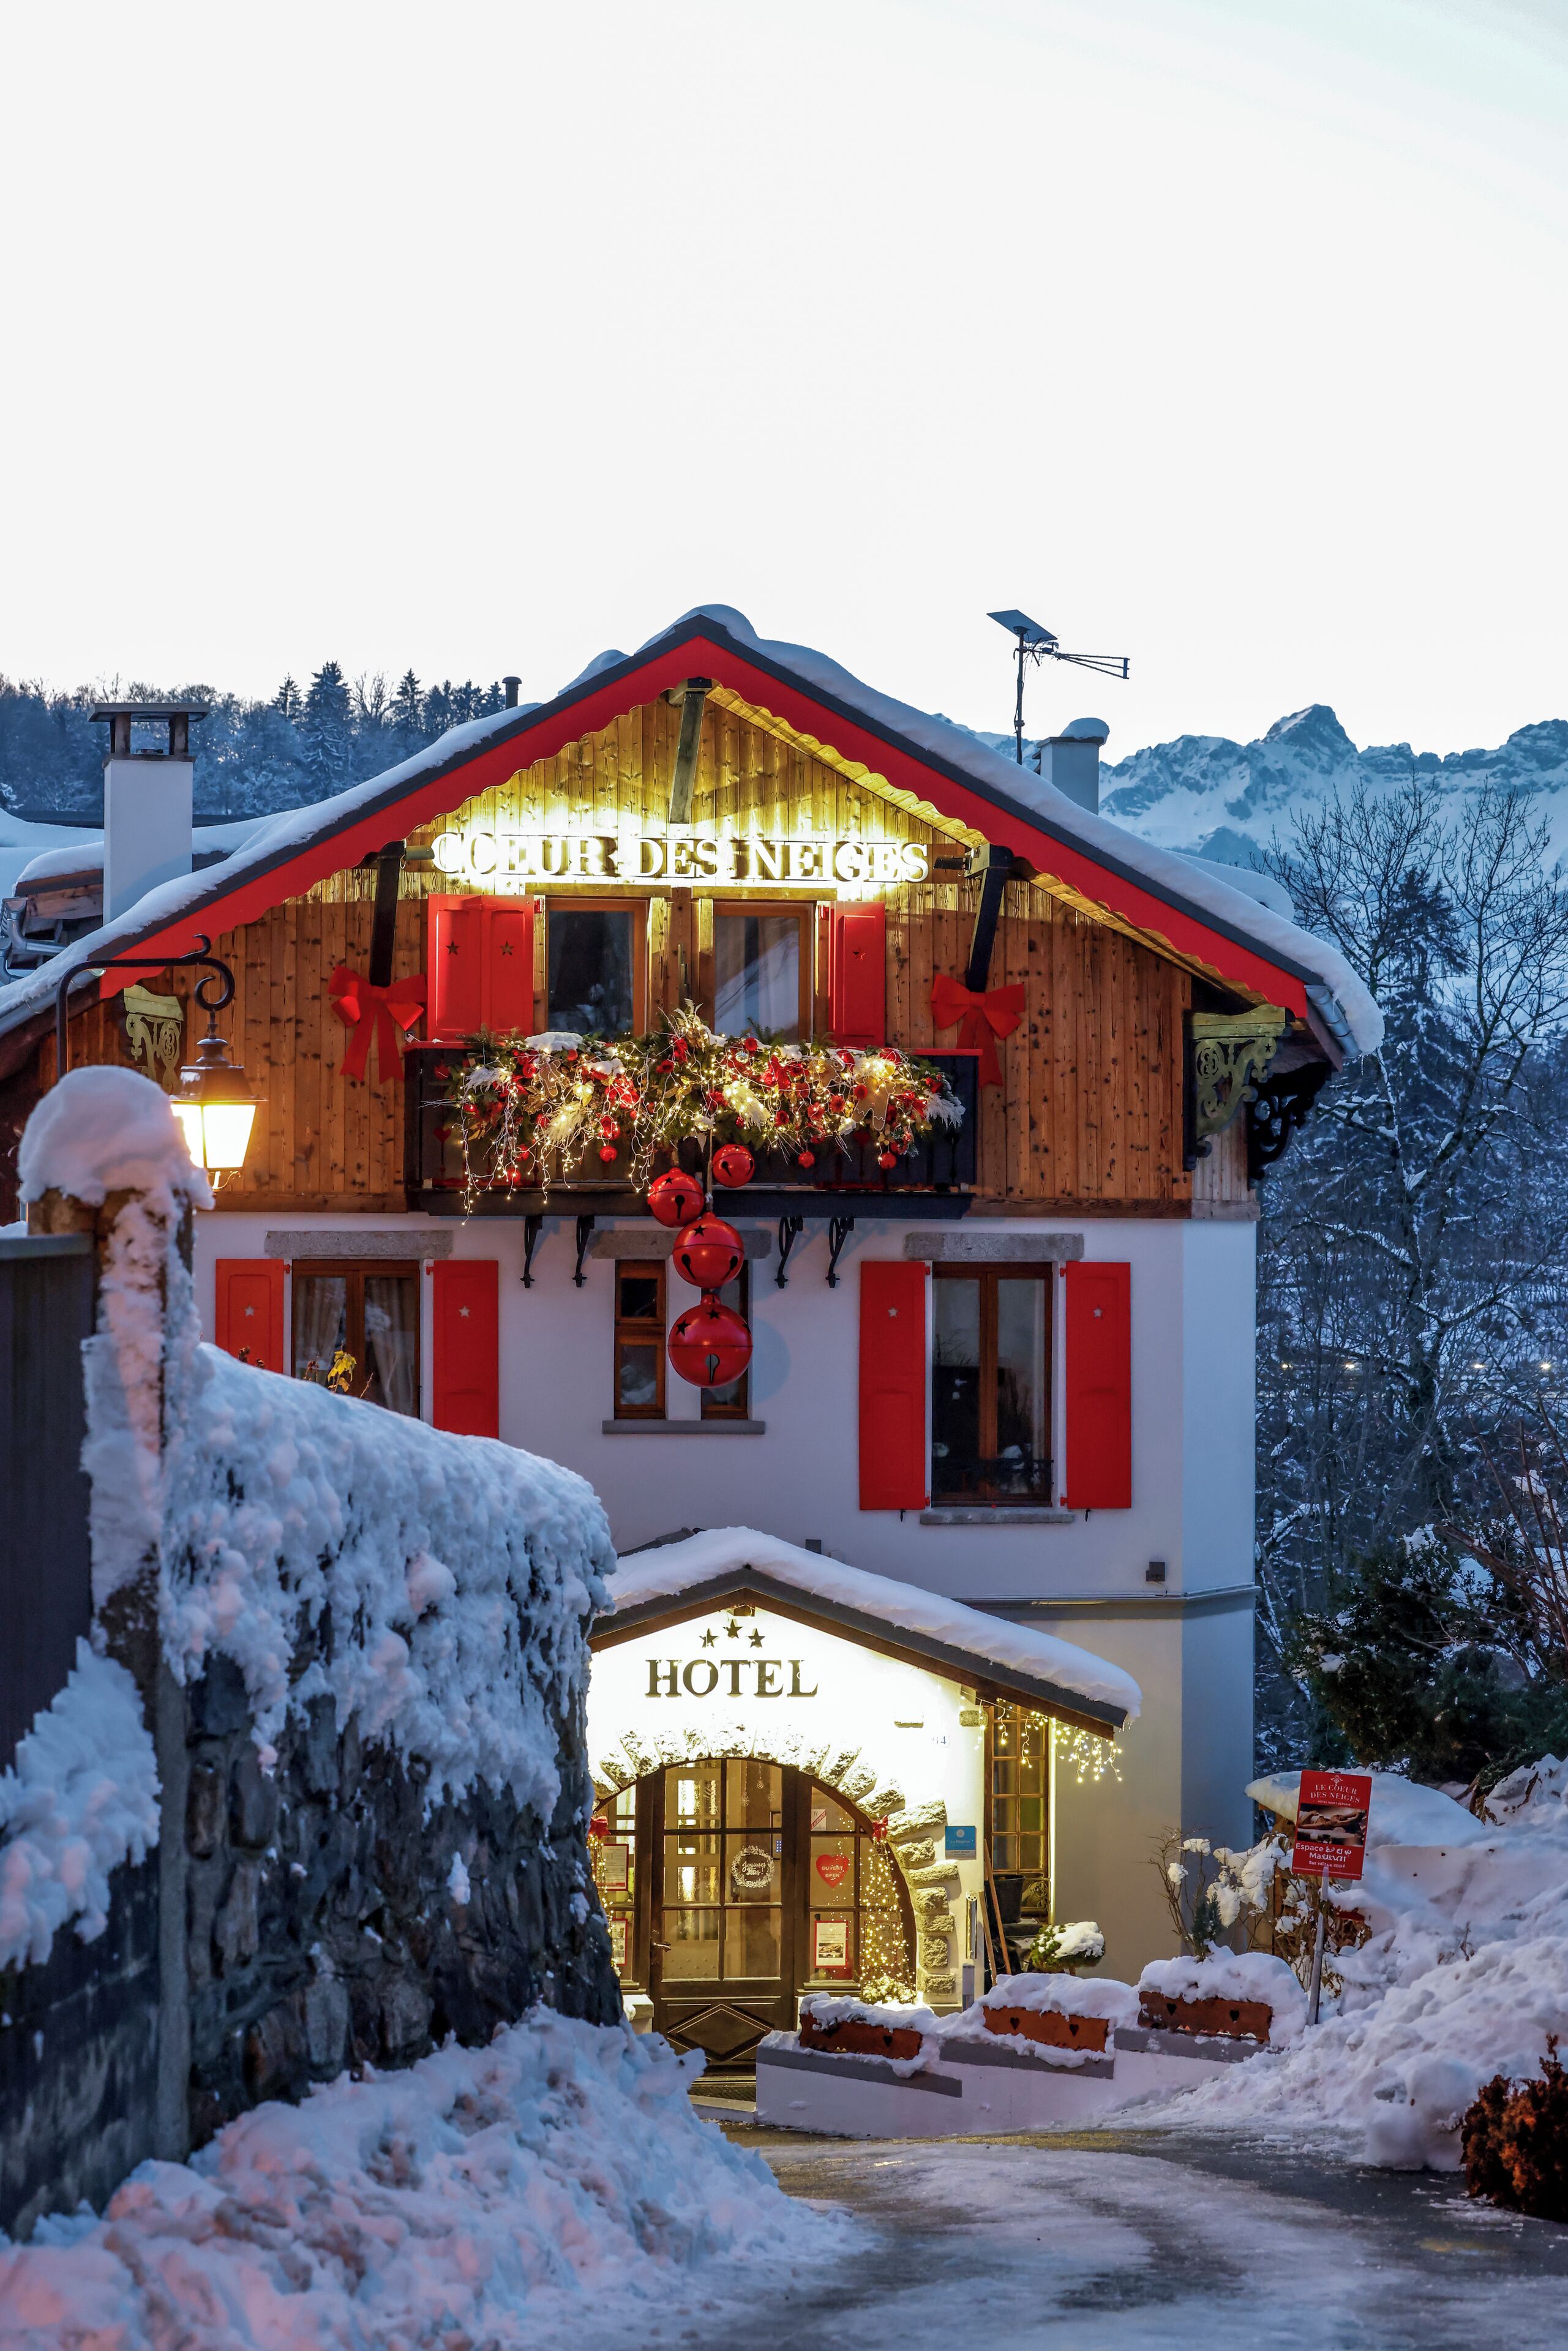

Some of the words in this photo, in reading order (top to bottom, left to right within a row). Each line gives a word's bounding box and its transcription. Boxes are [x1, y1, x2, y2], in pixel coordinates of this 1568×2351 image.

[628, 838, 720, 878] DES
[745, 841, 929, 883] NEIGES
[645, 1659, 819, 1698] HOTEL
[1330, 1793, 1360, 1803] NEIGES
[1296, 1843, 1324, 1851] Espace
